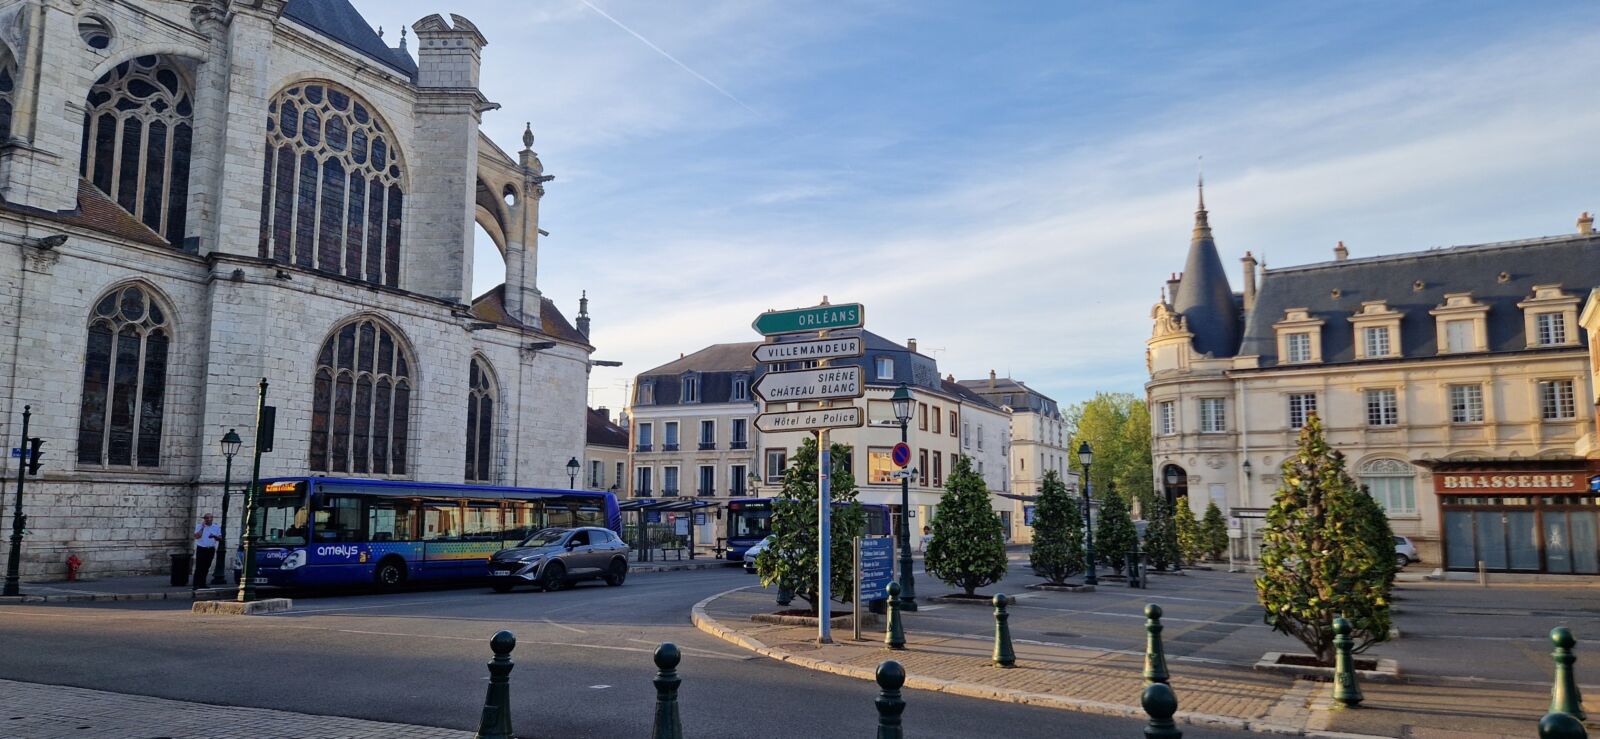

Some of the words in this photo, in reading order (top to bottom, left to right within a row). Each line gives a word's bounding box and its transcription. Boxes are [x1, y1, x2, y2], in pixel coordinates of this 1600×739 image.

[798, 310, 856, 326] ORLÉANS
[768, 342, 856, 358] VILLEMANDEUR
[818, 370, 855, 383] SIRÈNE
[770, 385, 815, 398] CHÂTEAU
[821, 382, 855, 394] BLANC
[774, 416, 799, 427] Hôtel
[805, 414, 817, 424] de
[823, 412, 855, 423] Police
[1443, 474, 1575, 489] BRASSERIE
[317, 544, 359, 559] amelys
